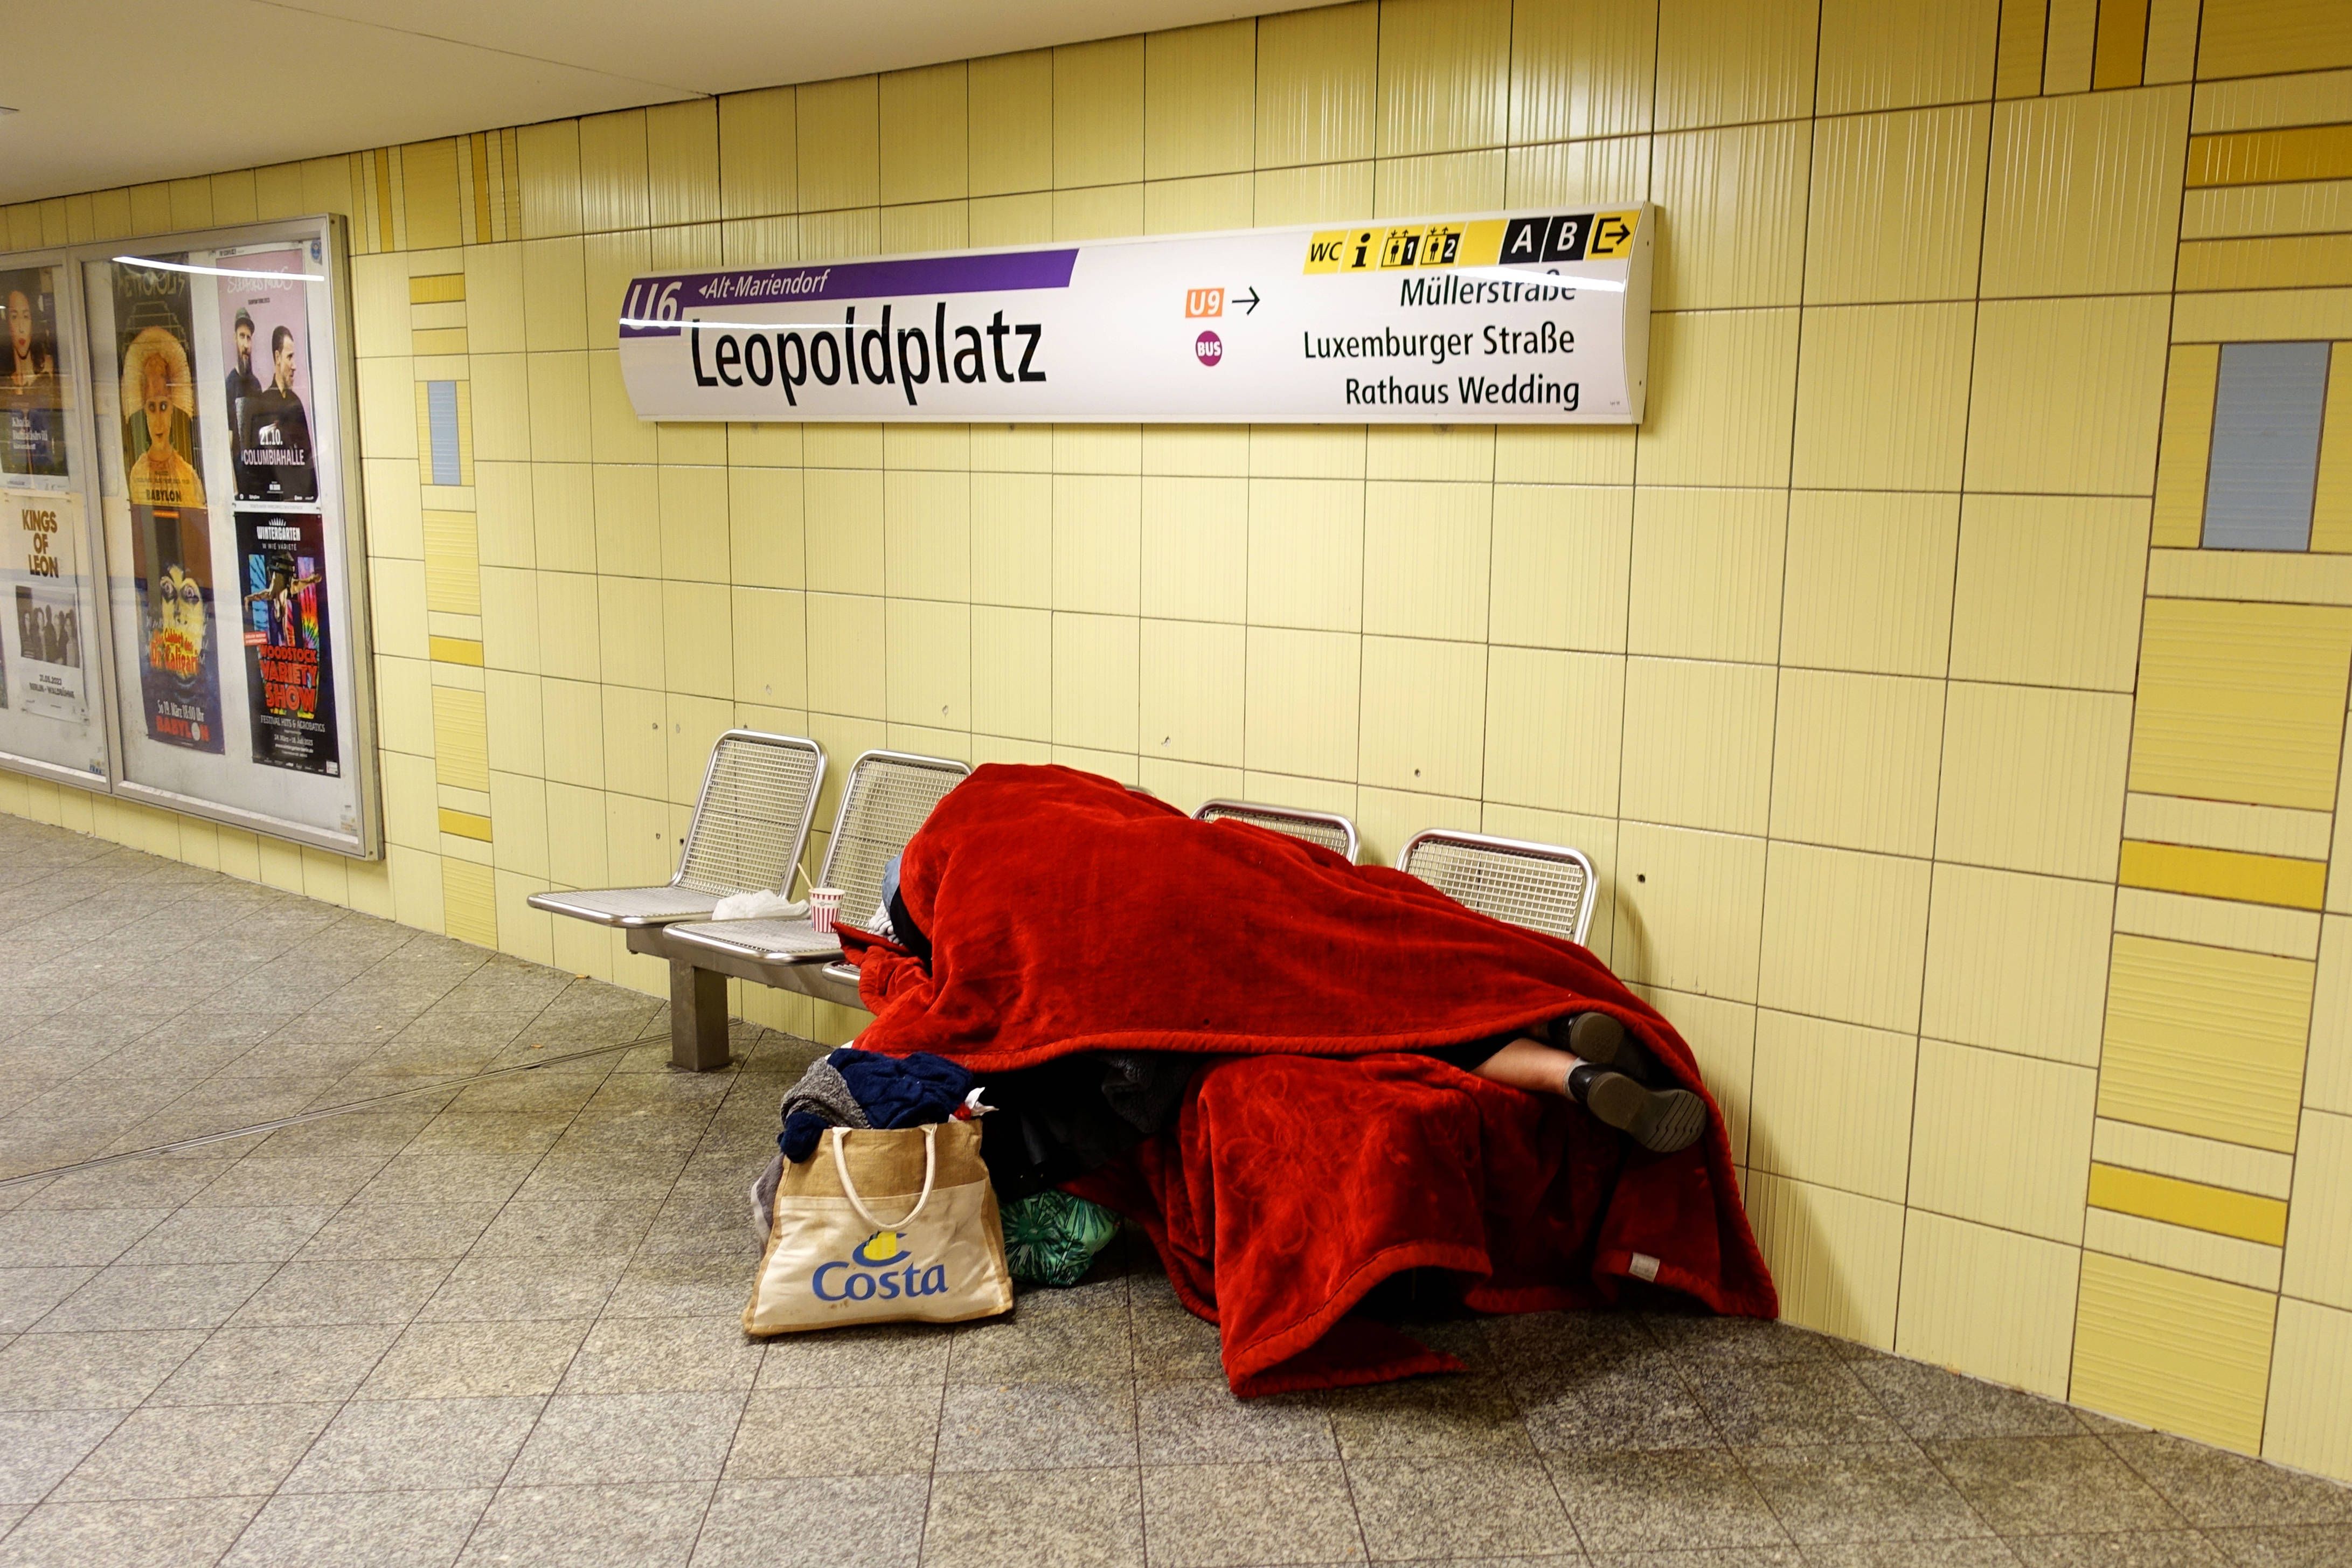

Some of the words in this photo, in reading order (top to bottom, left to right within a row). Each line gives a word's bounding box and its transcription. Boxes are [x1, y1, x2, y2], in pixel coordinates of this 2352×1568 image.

[1406, 239, 1415, 260] 1
[1444, 239, 1456, 258] 2
[1511, 224, 1532, 254] A
[1556, 221, 1579, 252] B
[1310, 241, 1343, 262] WC
[705, 268, 831, 299] Alt-Mariendorf
[1400, 268, 1576, 307] Müllerstraße
[627, 281, 683, 331] U6
[1189, 290, 1221, 316] U9
[691, 302, 1047, 407] Leopoldplatz
[1197, 341, 1222, 358] BUS
[1304, 326, 1474, 364] Luxemburger
[1483, 321, 1575, 354] Straße
[1346, 376, 1449, 405] Rathaus
[1458, 373, 1580, 411] Wedding
[260, 429, 283, 446] 21.10.
[244, 448, 306, 466] COLUMBIAHALLE
[146, 489, 182, 502] BABYLON
[22, 509, 58, 533] KINGS
[256, 526, 301, 542] WINTERGARTEN
[33, 532, 49, 554] OF
[28, 554, 59, 578] LEON
[164, 644, 200, 678] Caligari
[259, 645, 317, 664] WOODSTOCK
[259, 660, 318, 686] VARIETY
[265, 682, 316, 712] SHOW
[156, 715, 211, 742] BABYLON
[260, 714, 281, 727] FESTIVAL
[281, 718, 292, 728] HITS
[297, 719, 325, 733] ACROBATICS
[812, 1261, 949, 1302] Costa
